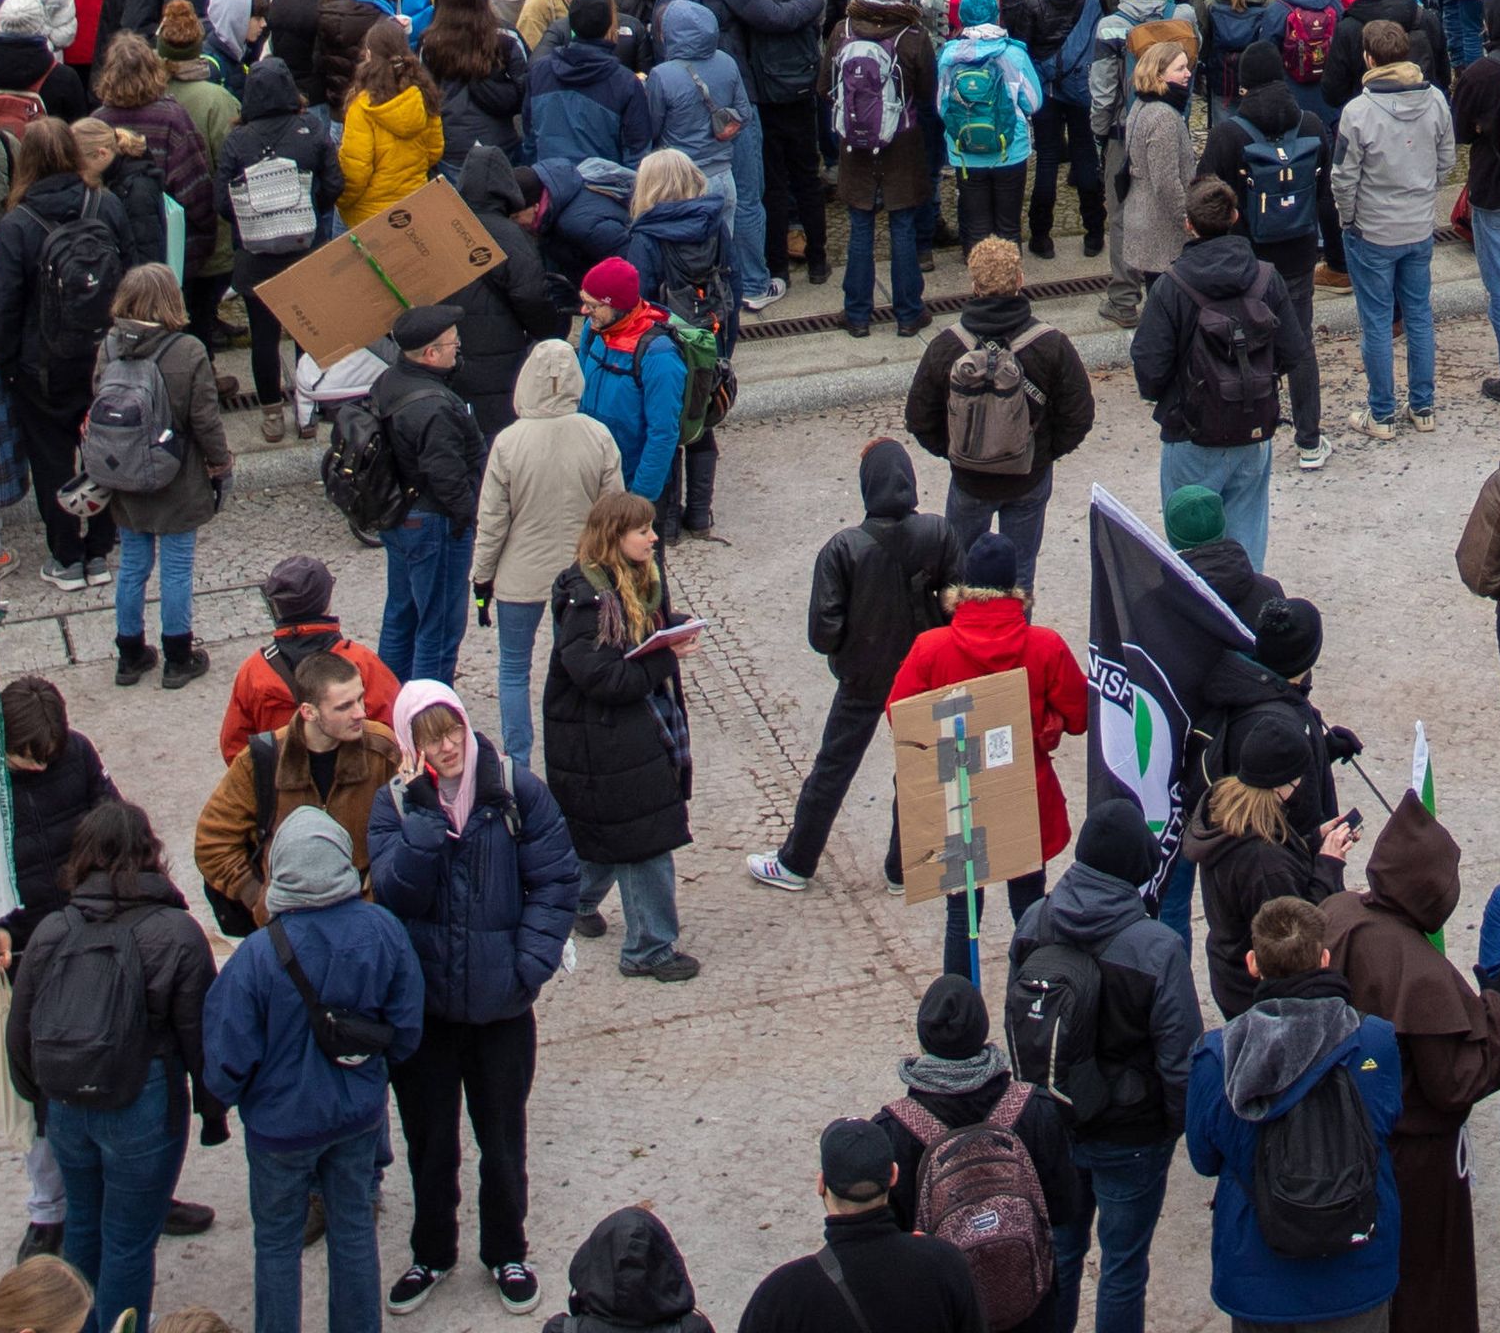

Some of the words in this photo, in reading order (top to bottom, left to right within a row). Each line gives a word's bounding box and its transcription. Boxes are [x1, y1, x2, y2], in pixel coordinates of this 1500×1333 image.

[388, 209, 412, 229] hp
[404, 227, 430, 257] Desktop
[451, 218, 477, 249] Desktop
[469, 246, 492, 267] hp
